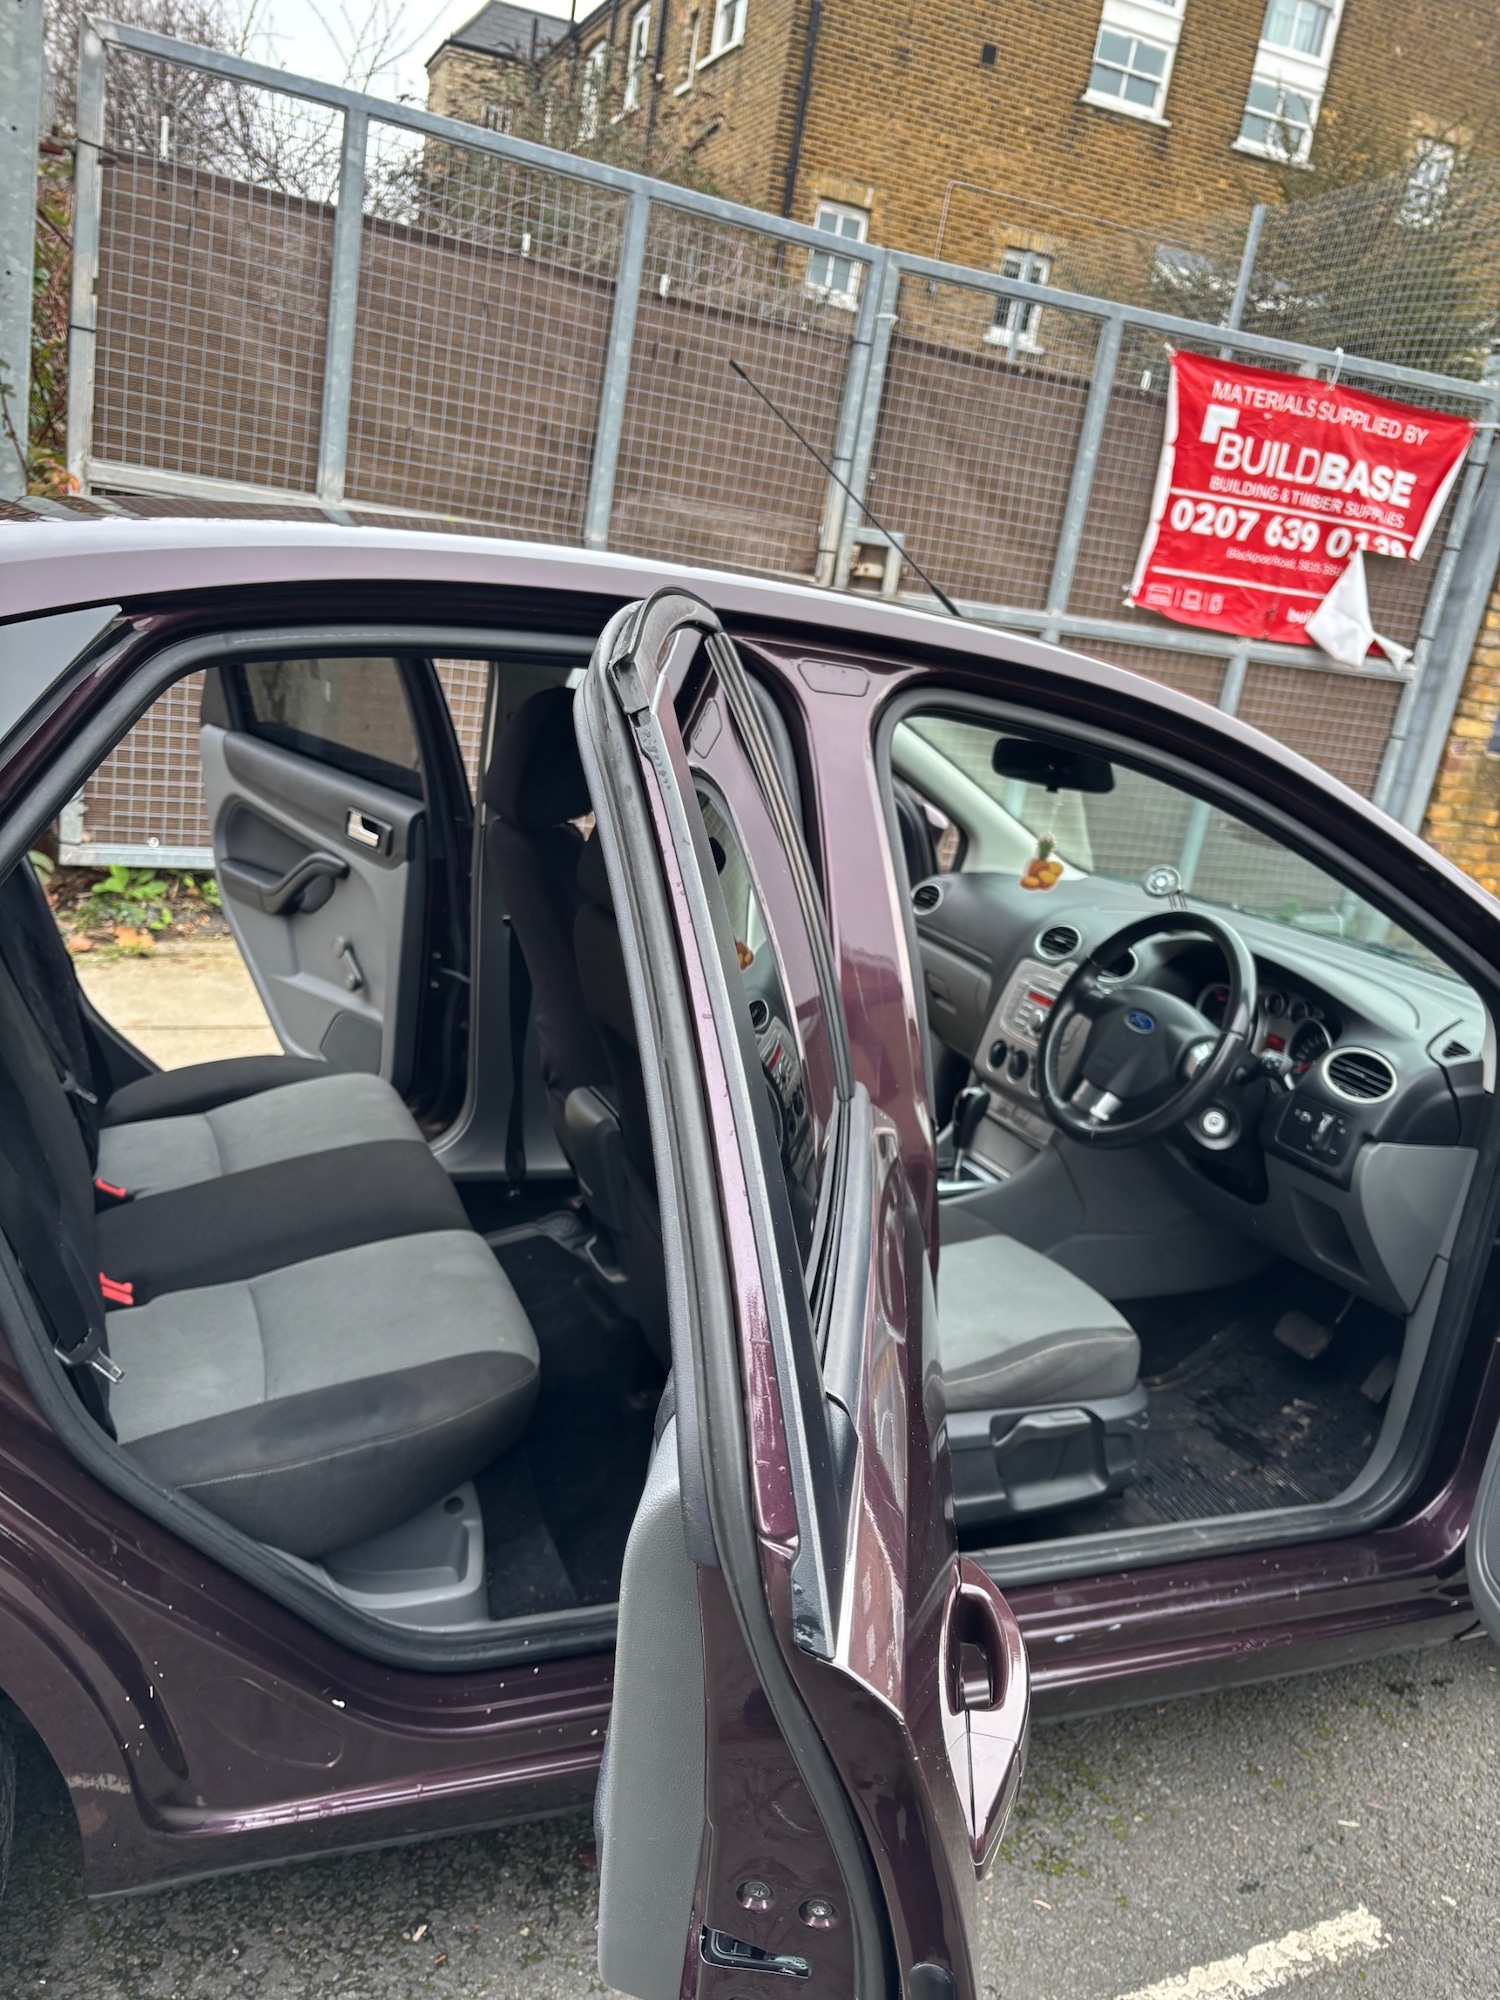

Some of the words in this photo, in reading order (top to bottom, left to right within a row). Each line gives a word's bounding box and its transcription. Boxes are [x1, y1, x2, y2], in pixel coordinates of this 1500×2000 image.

[1211, 380, 1317, 418] MATERIALS
[1317, 400, 1402, 439] SUPPLIED
[1403, 423, 1429, 446] BY
[1214, 431, 1418, 508] BUILDBASE
[1170, 498, 1261, 542] 0207
[1264, 515, 1320, 553] 639
[1209, 475, 1279, 501] BUILDING
[1280, 488, 1290, 504] &
[1291, 491, 1344, 516] TIMBER
[1345, 502, 1406, 529] SUPPLIES
